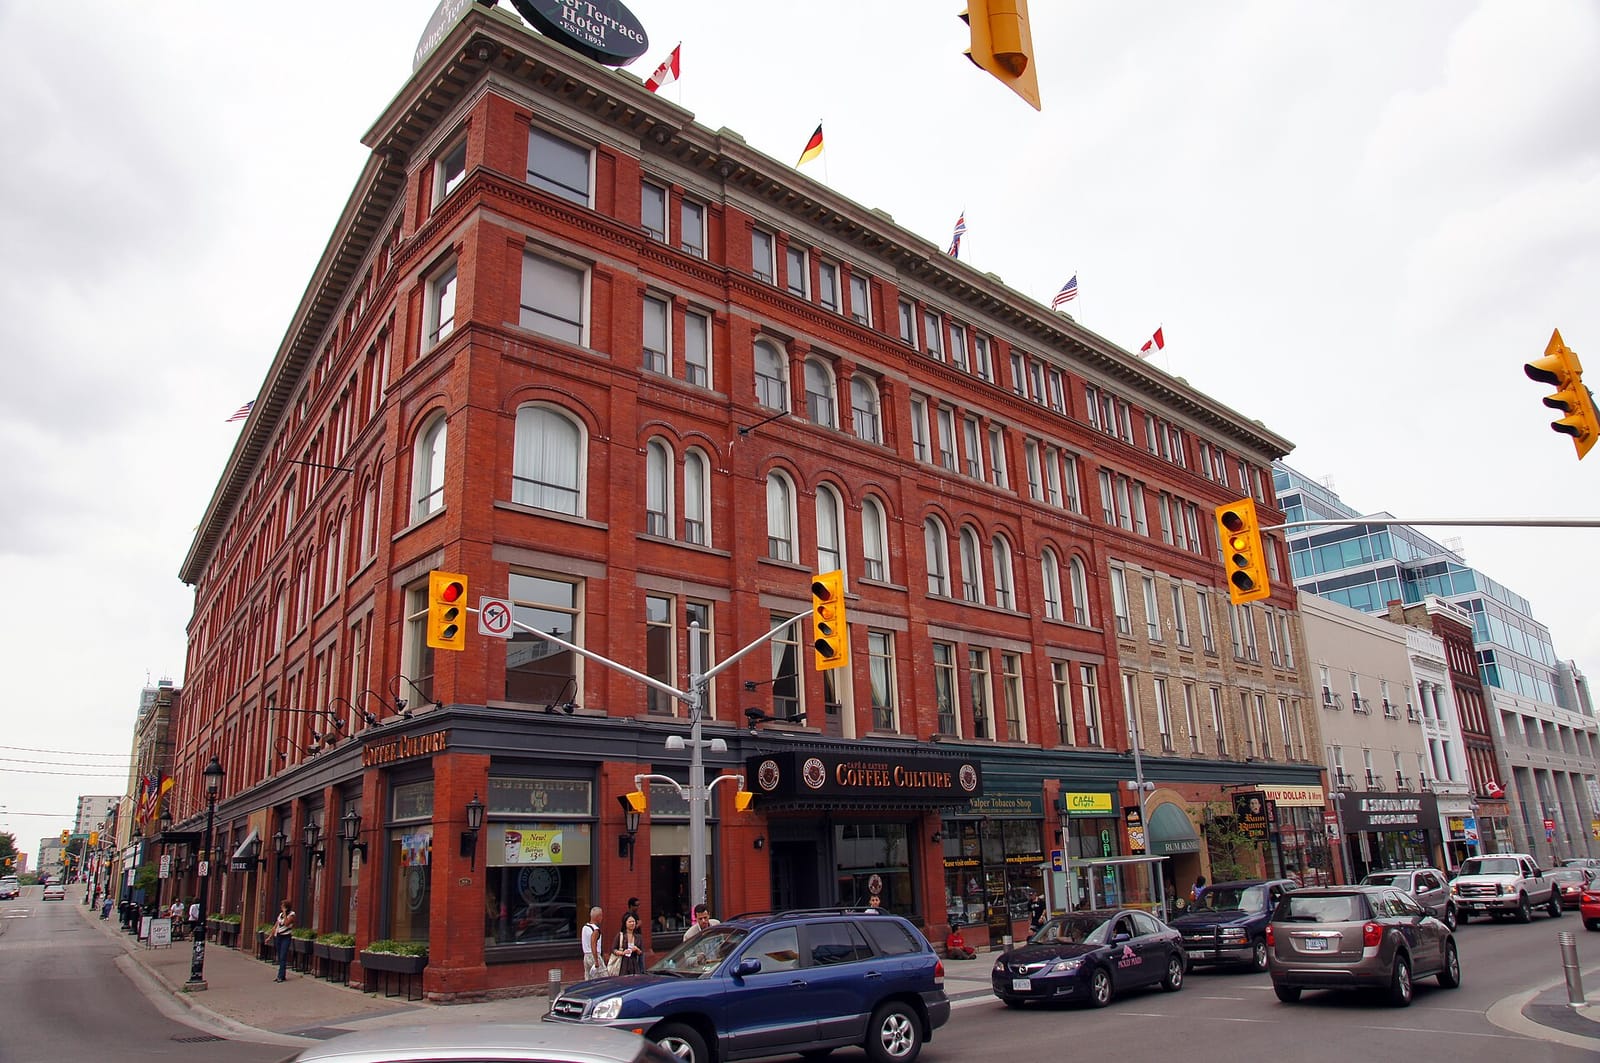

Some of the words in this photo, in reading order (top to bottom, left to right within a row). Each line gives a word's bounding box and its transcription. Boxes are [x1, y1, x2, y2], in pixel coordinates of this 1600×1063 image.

[562, 5, 605, 39] Hotel
[584, 1, 644, 44] Terrace
[563, 23, 583, 37] EST.
[584, 32, 602, 47] 1893
[400, 730, 447, 759] CULTURE
[836, 763, 890, 786] COFFEE
[893, 766, 952, 788] CULTURE
[991, 798, 1016, 807] Tobacco
[1016, 798, 1032, 809] Shop
[1283, 791, 1307, 800] DOLLAR
[530, 833, 547, 841] New!
[1165, 842, 1181, 851] RUM
